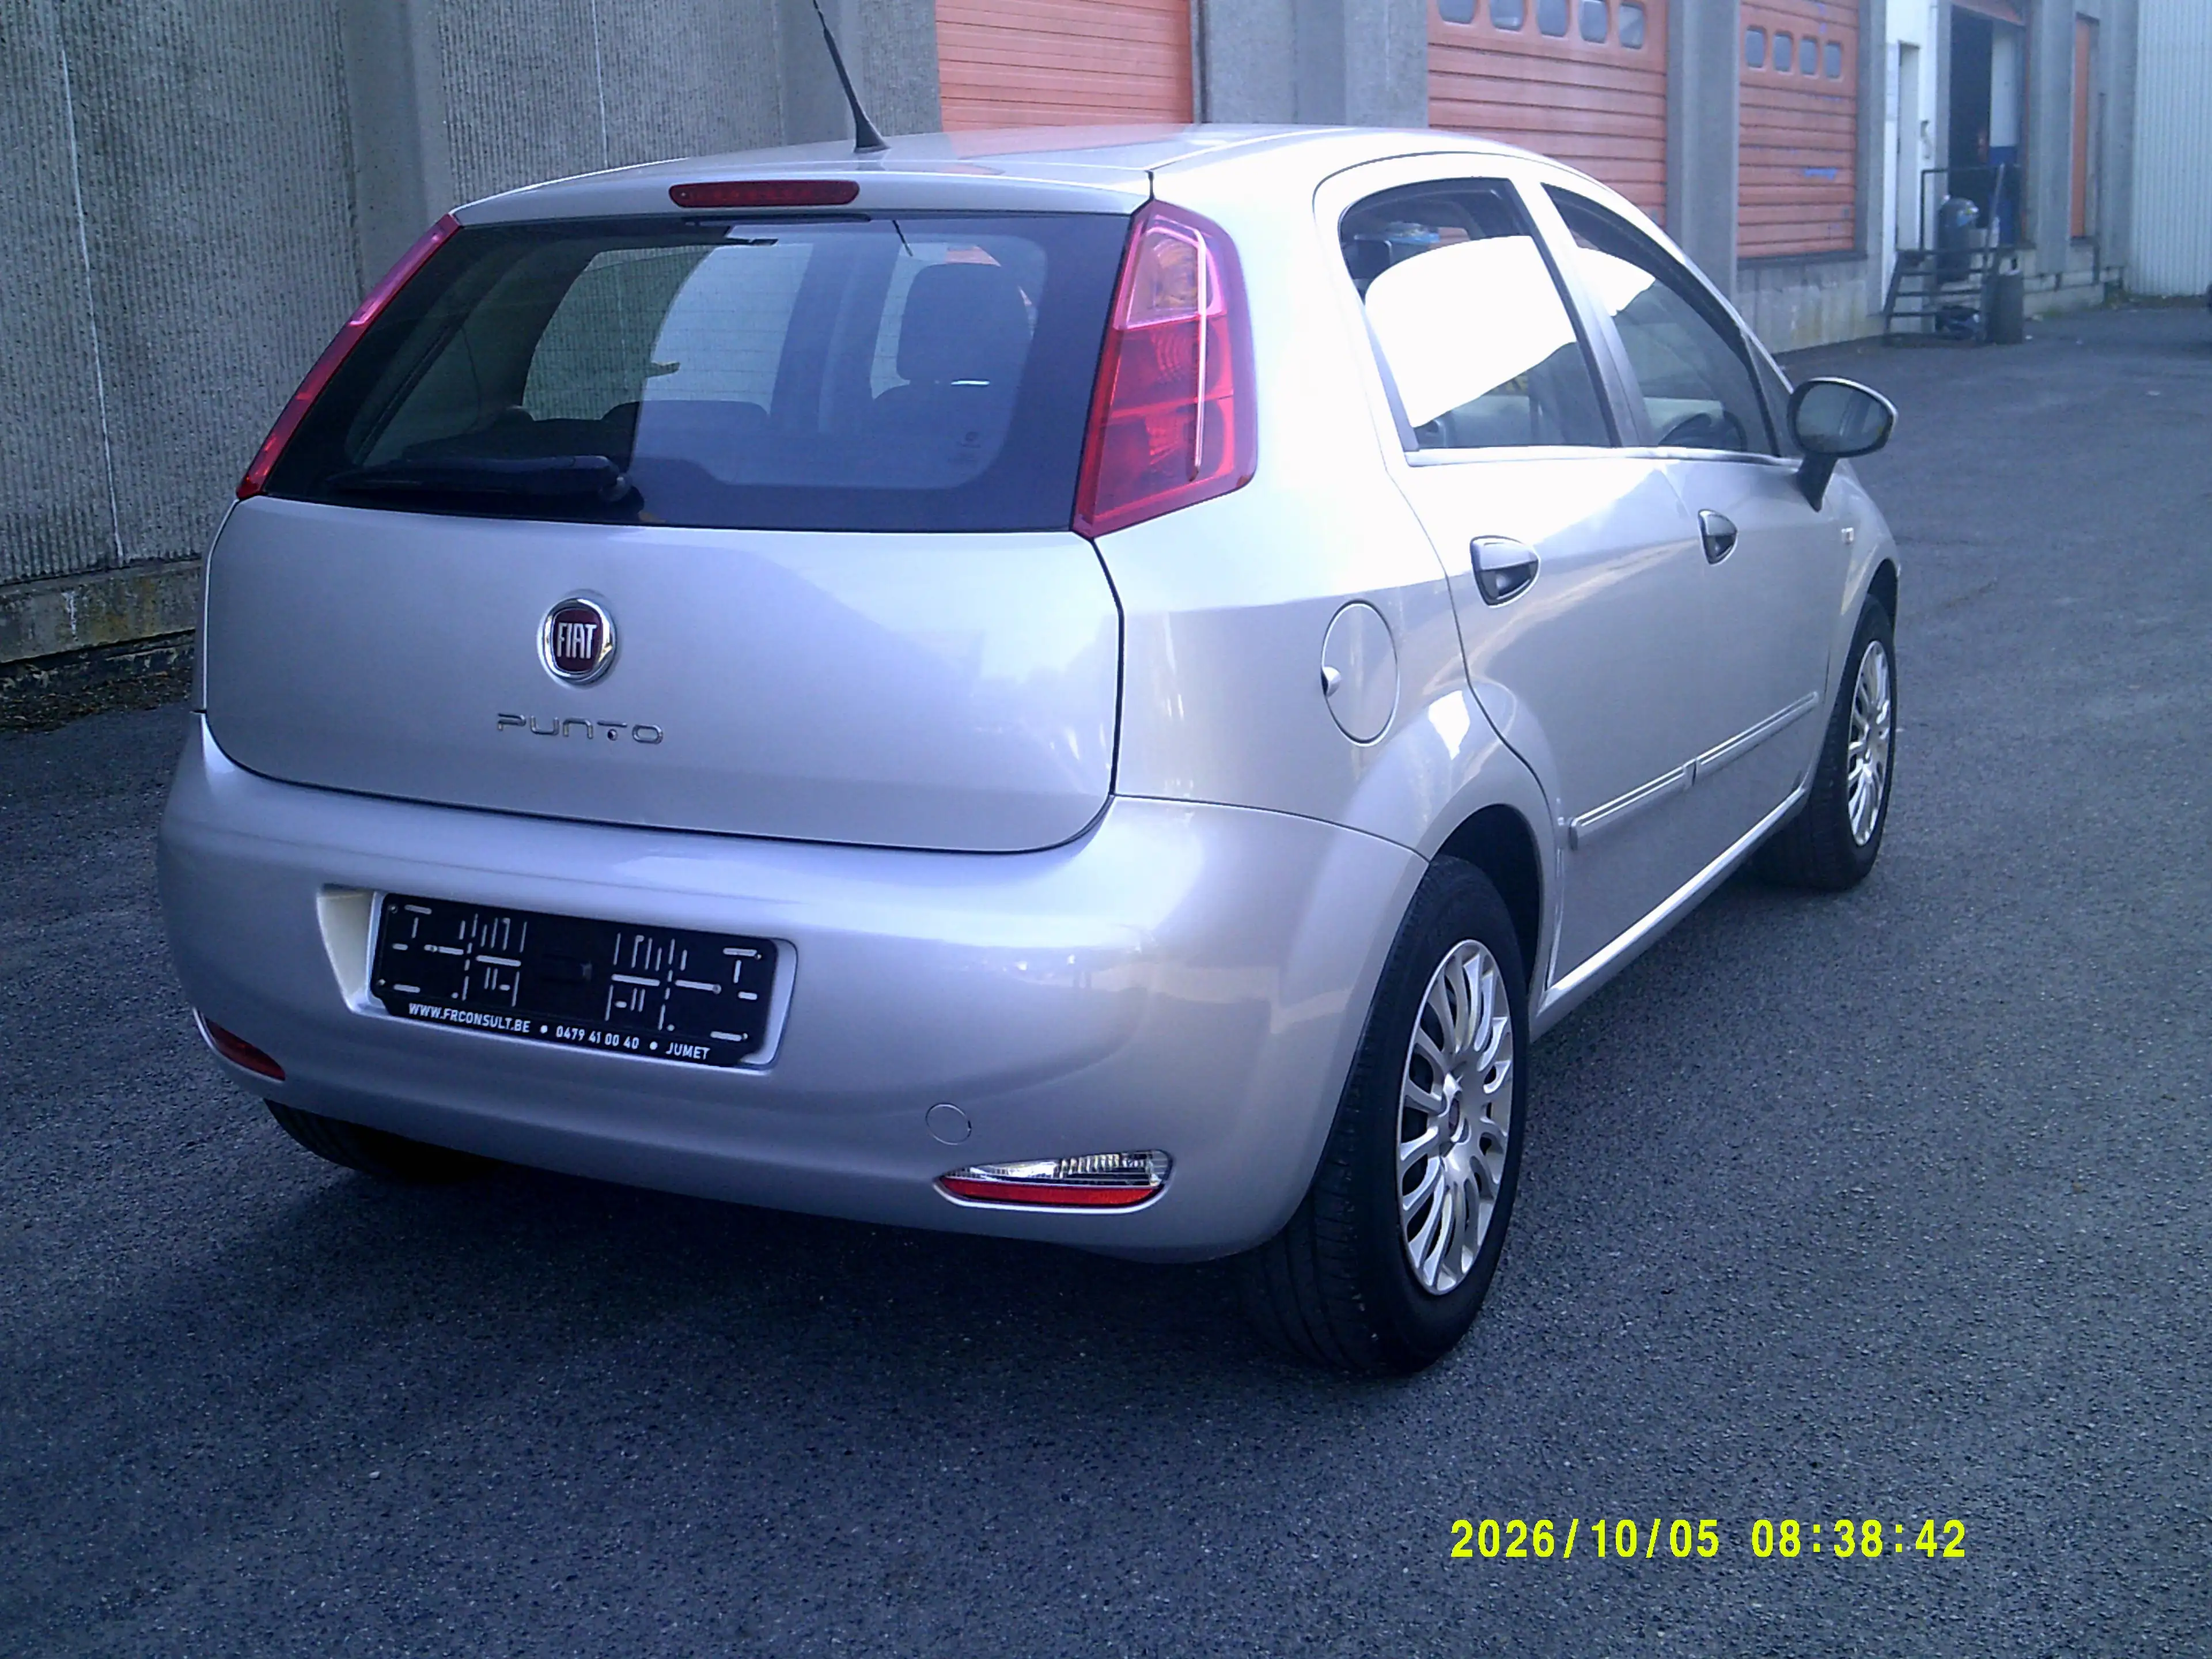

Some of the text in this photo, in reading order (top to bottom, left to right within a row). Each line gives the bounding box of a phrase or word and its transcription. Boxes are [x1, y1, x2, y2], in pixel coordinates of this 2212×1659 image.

[556, 622, 597, 659] FIAT
[408, 1002, 711, 1060] WWW.FRCONSULT.BE 0479 41 00 40 JUMET
